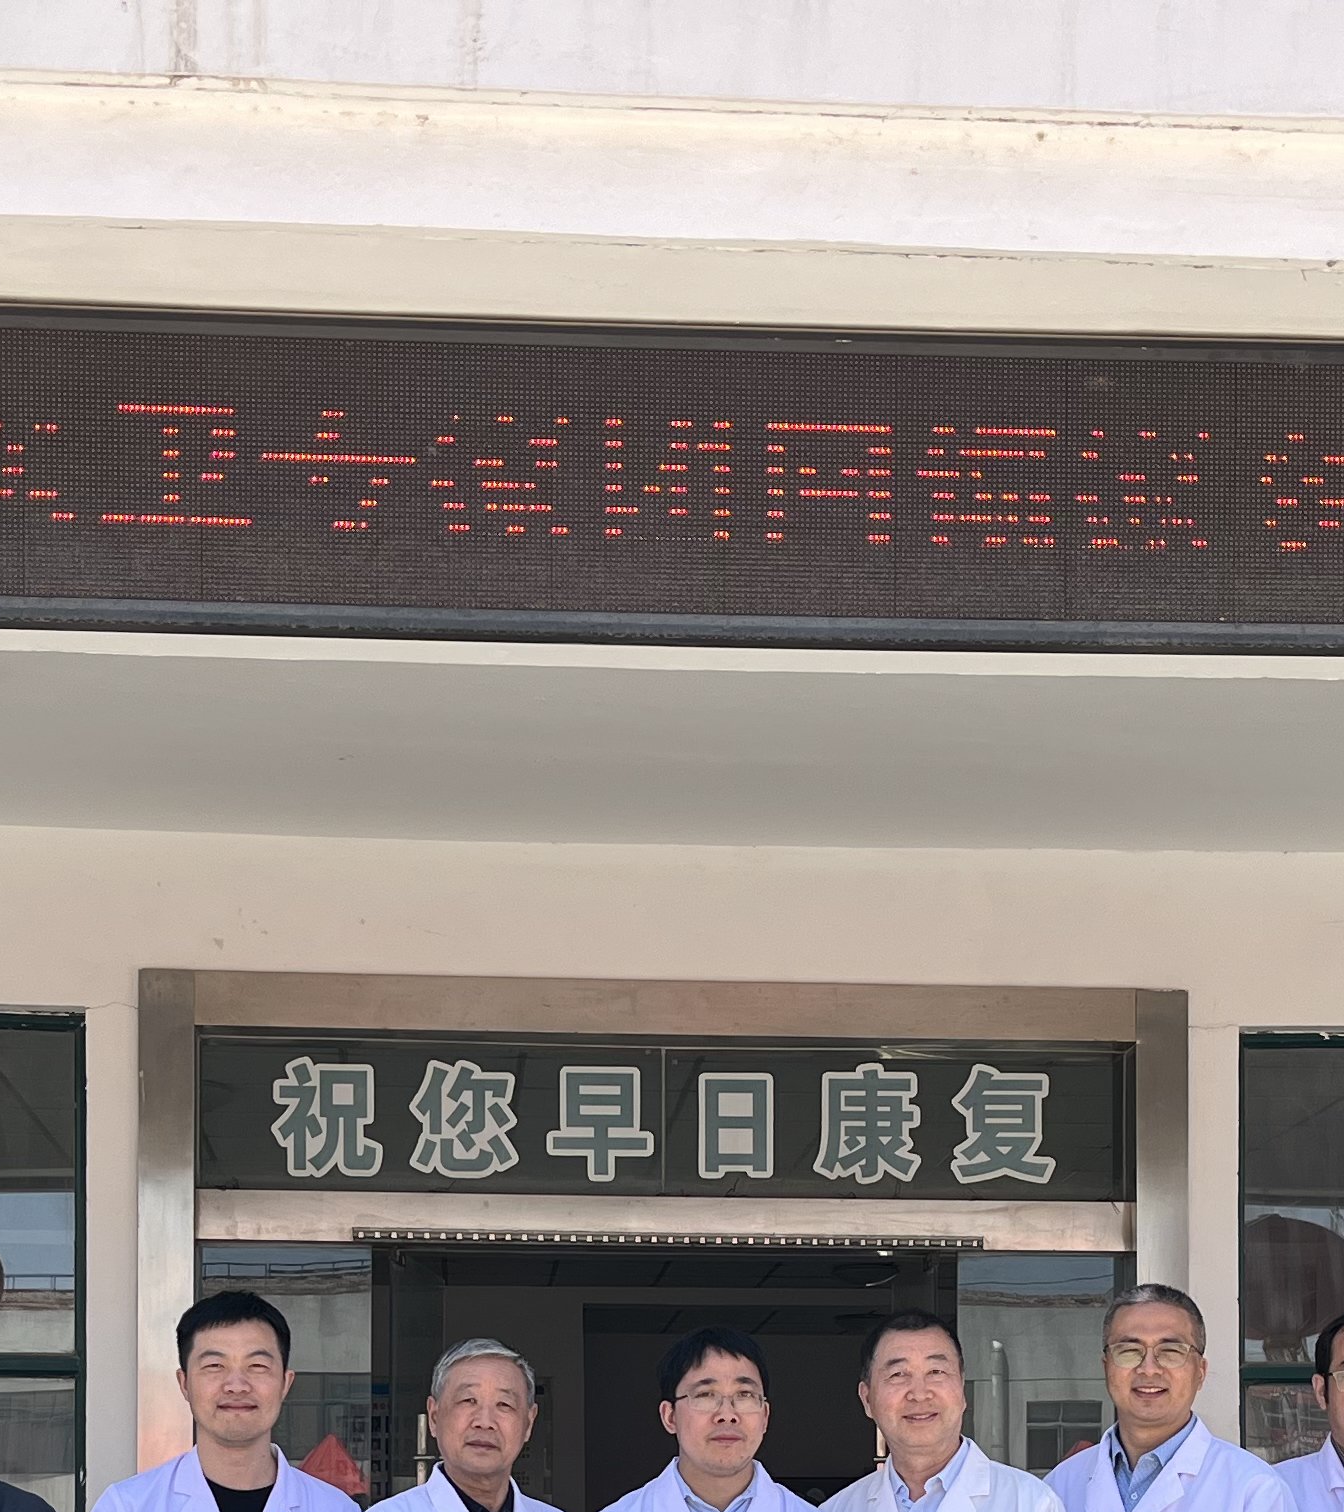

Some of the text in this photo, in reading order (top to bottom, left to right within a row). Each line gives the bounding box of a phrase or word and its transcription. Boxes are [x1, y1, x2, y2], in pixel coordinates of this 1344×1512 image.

[273, 1056, 1056, 1184] 祝您早日康复
